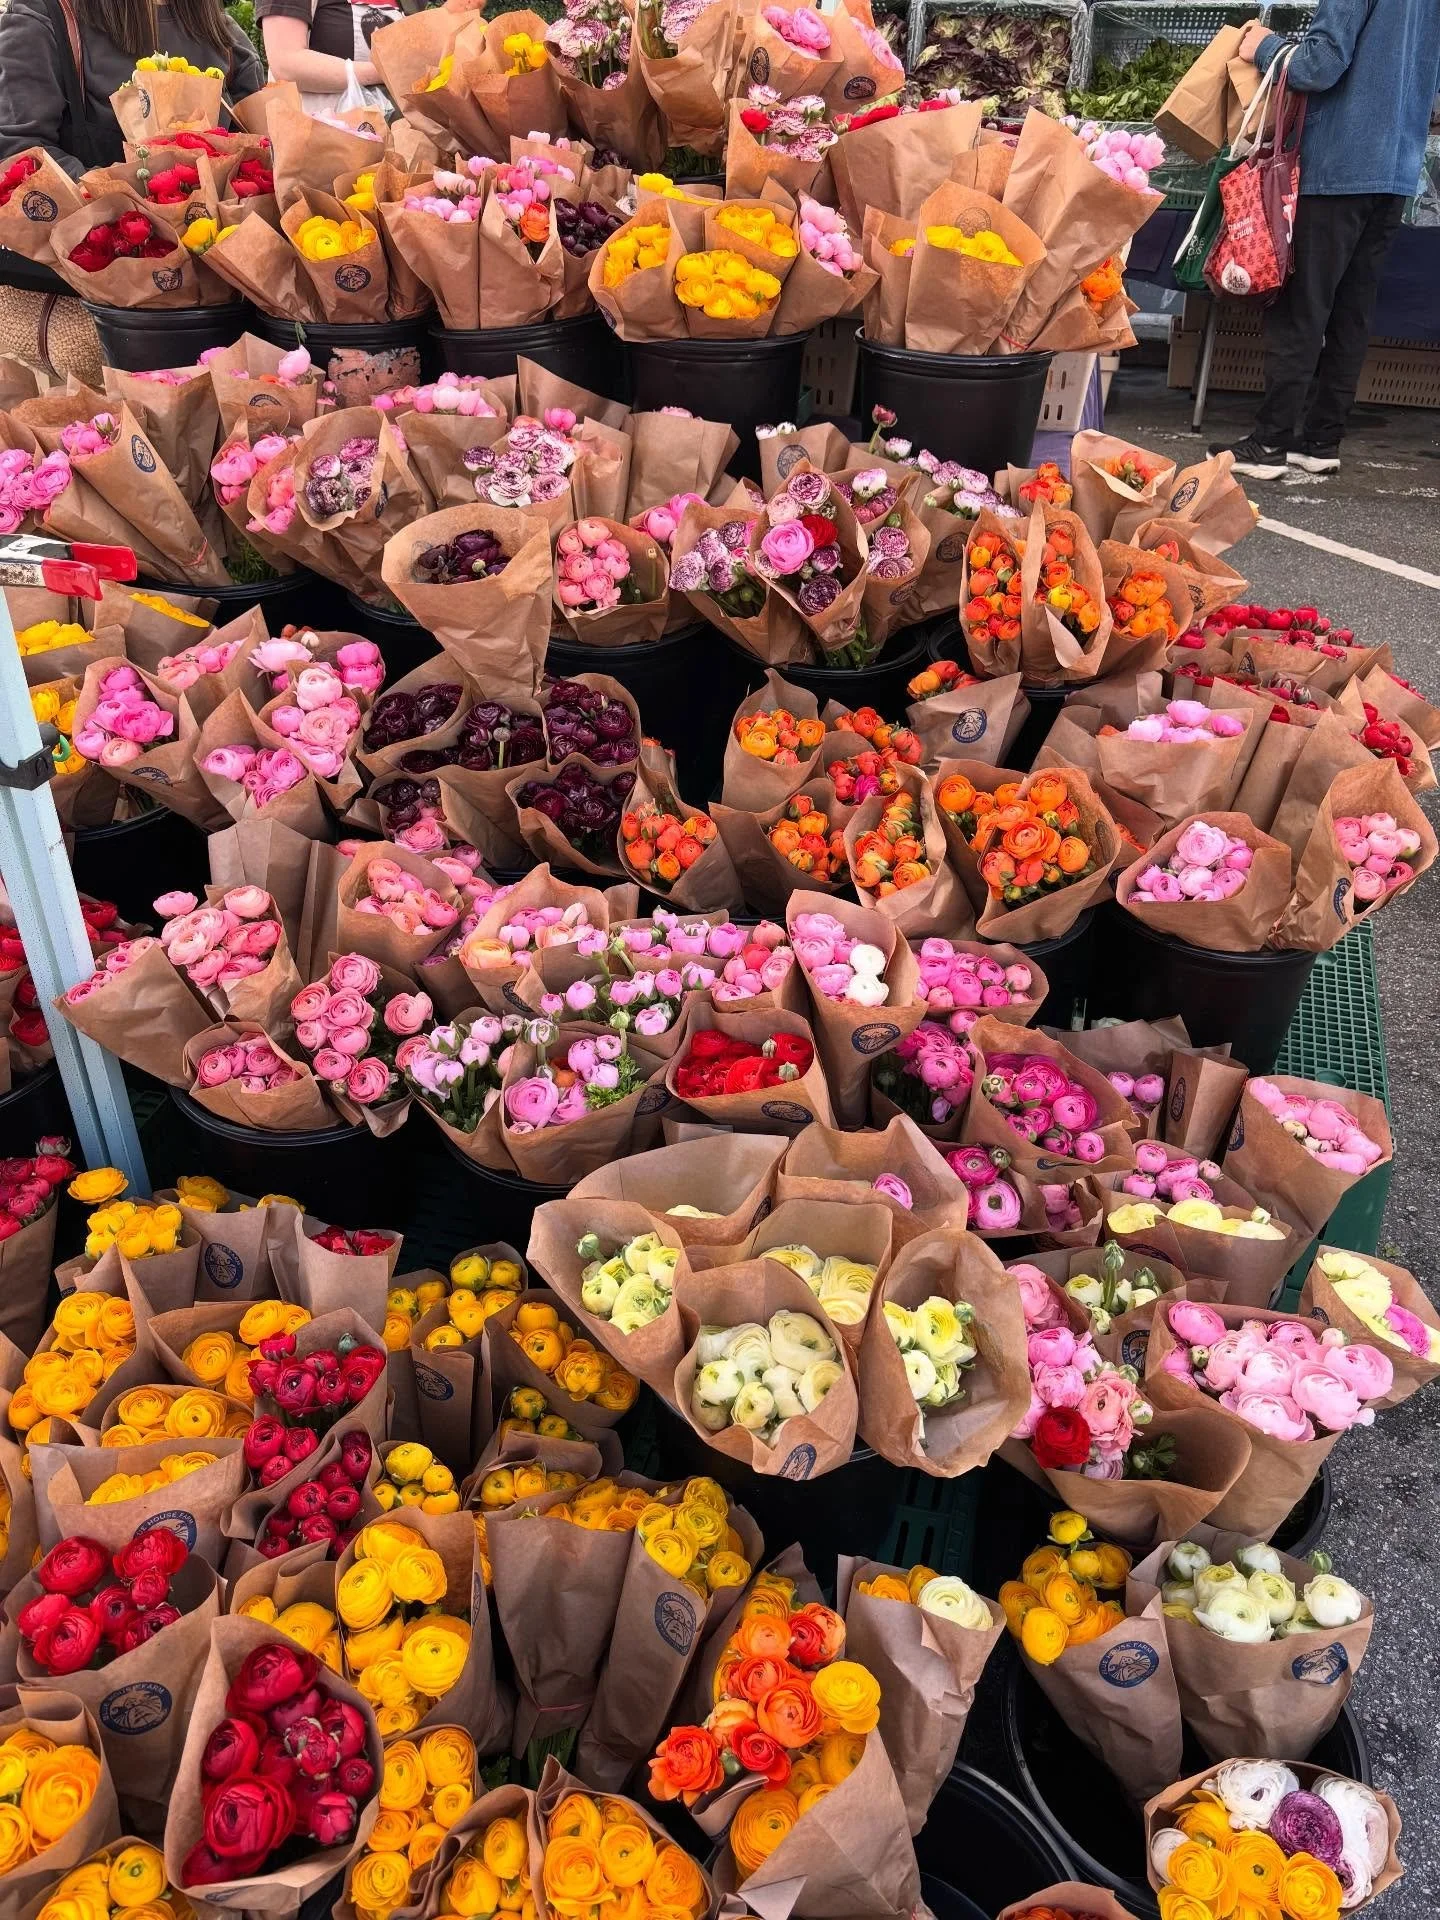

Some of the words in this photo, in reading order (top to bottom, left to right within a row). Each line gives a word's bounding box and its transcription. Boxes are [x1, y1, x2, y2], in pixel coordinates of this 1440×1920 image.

[147, 1512, 177, 1526] HOUSE
[178, 1512, 194, 1524] FARM
[1133, 1642, 1153, 1653] FARM
[141, 1683, 165, 1694] FARM
